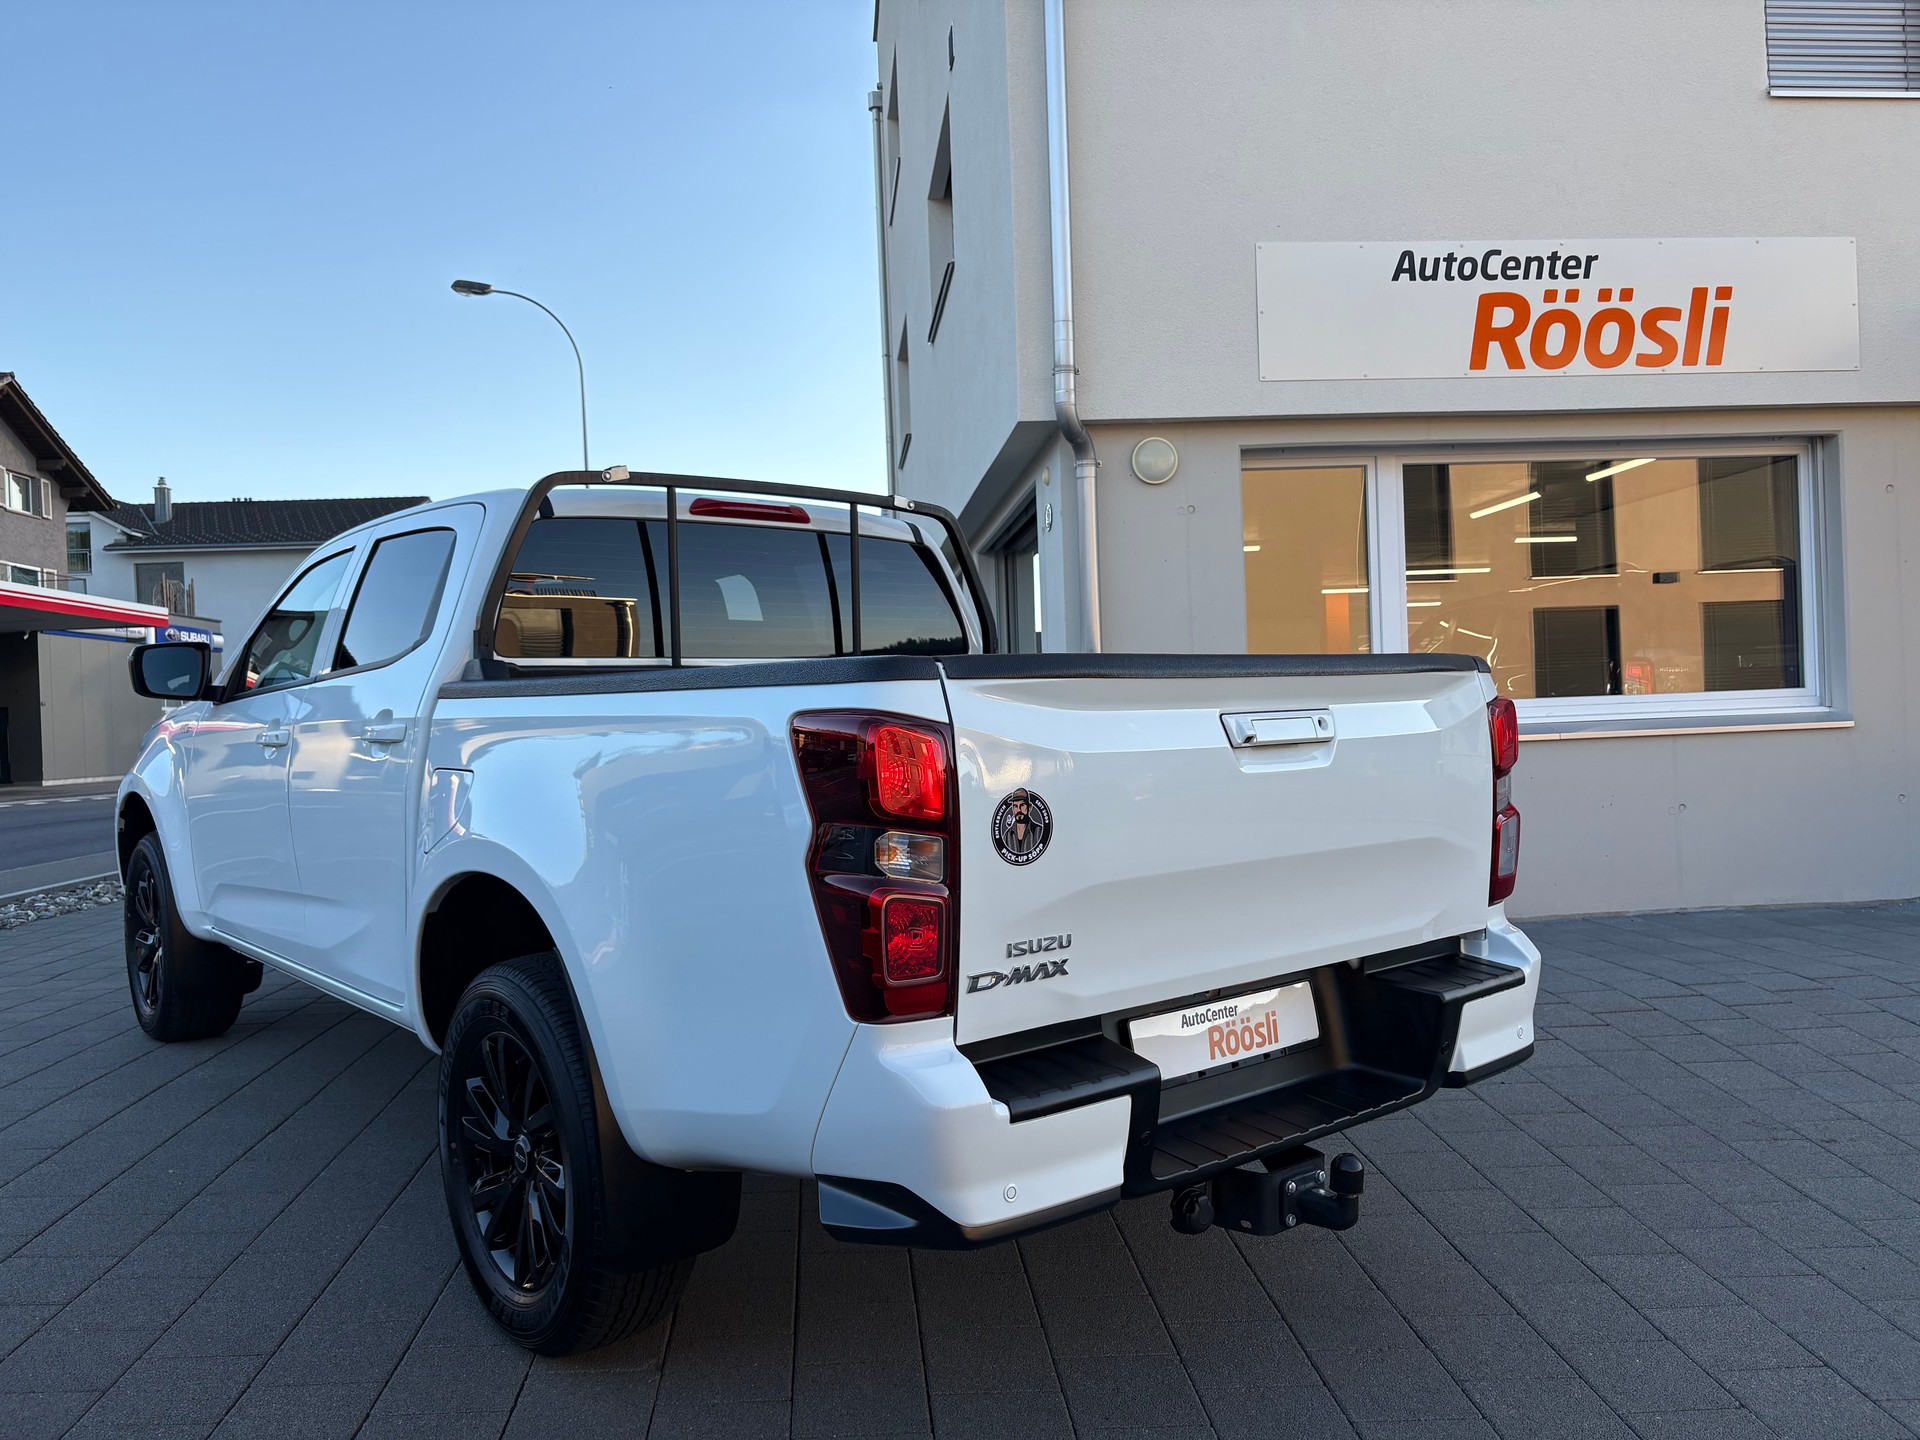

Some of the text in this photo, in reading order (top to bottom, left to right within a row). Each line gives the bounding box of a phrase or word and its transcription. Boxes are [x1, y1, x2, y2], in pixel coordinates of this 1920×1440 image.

[1391, 249, 1600, 282] AutoCenter
[1468, 285, 1733, 371] Röösli
[180, 631, 210, 643] SUBARU
[1035, 799, 1044, 809] SEIT
[994, 804, 1007, 839] ENTLEBUCH
[1001, 848, 1028, 863] PICK-UP
[1006, 933, 1072, 959] ISUZU
[967, 957, 1070, 994] D-MAX
[1181, 1004, 1239, 1029] AutoCenter
[1207, 1010, 1280, 1061] Röösli
